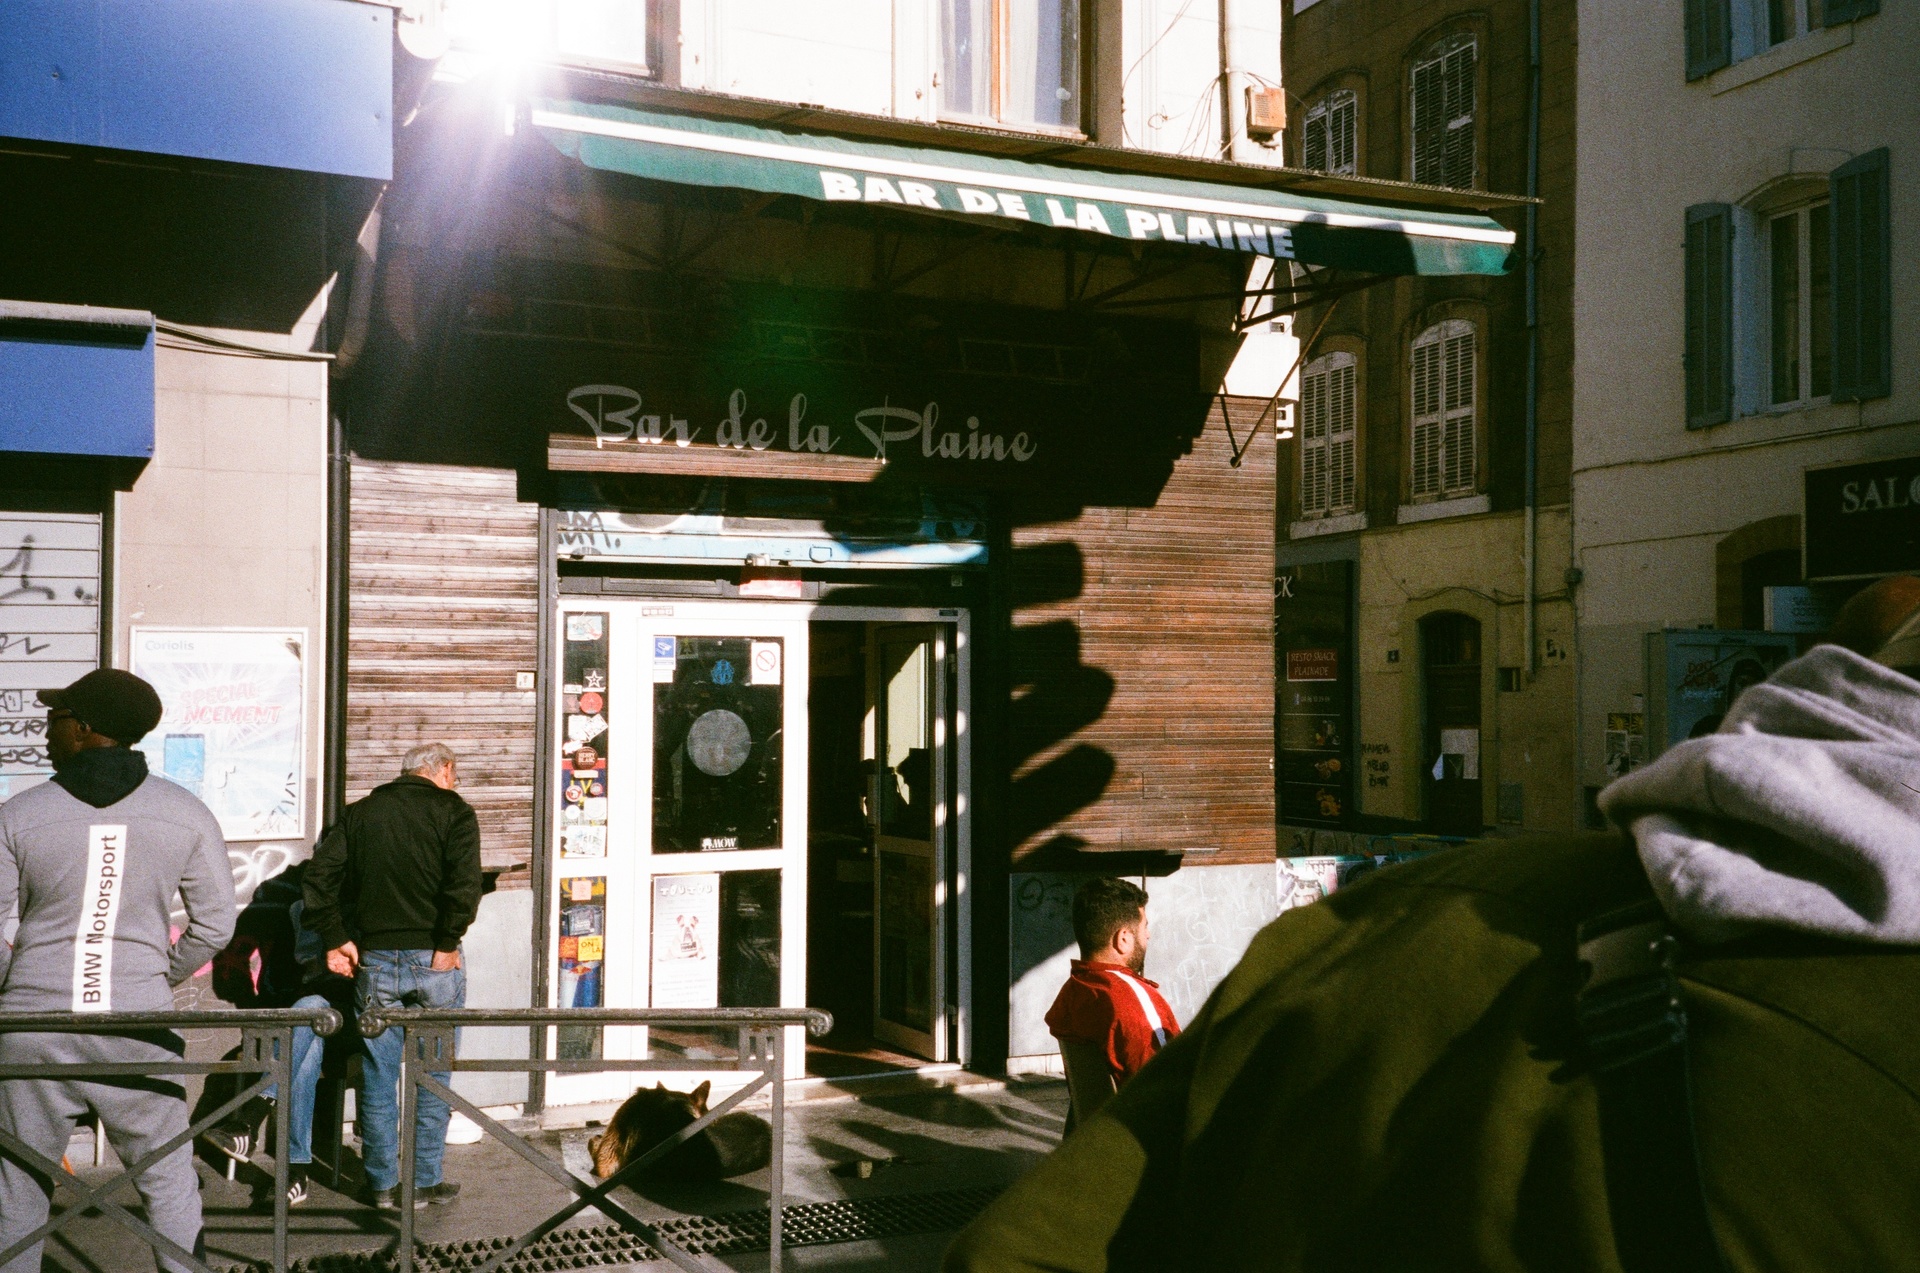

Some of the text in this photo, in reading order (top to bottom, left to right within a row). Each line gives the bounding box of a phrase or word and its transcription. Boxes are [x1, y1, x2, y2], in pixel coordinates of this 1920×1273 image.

[819, 171, 1296, 258] BAR DE LA PLAINE
[567, 384, 1037, 464] Bar de la Plaine
[144, 639, 195, 652] Coriolis
[1290, 651, 1336, 662] RESTO SNACK
[83, 835, 118, 1004] BMW Motorsport
